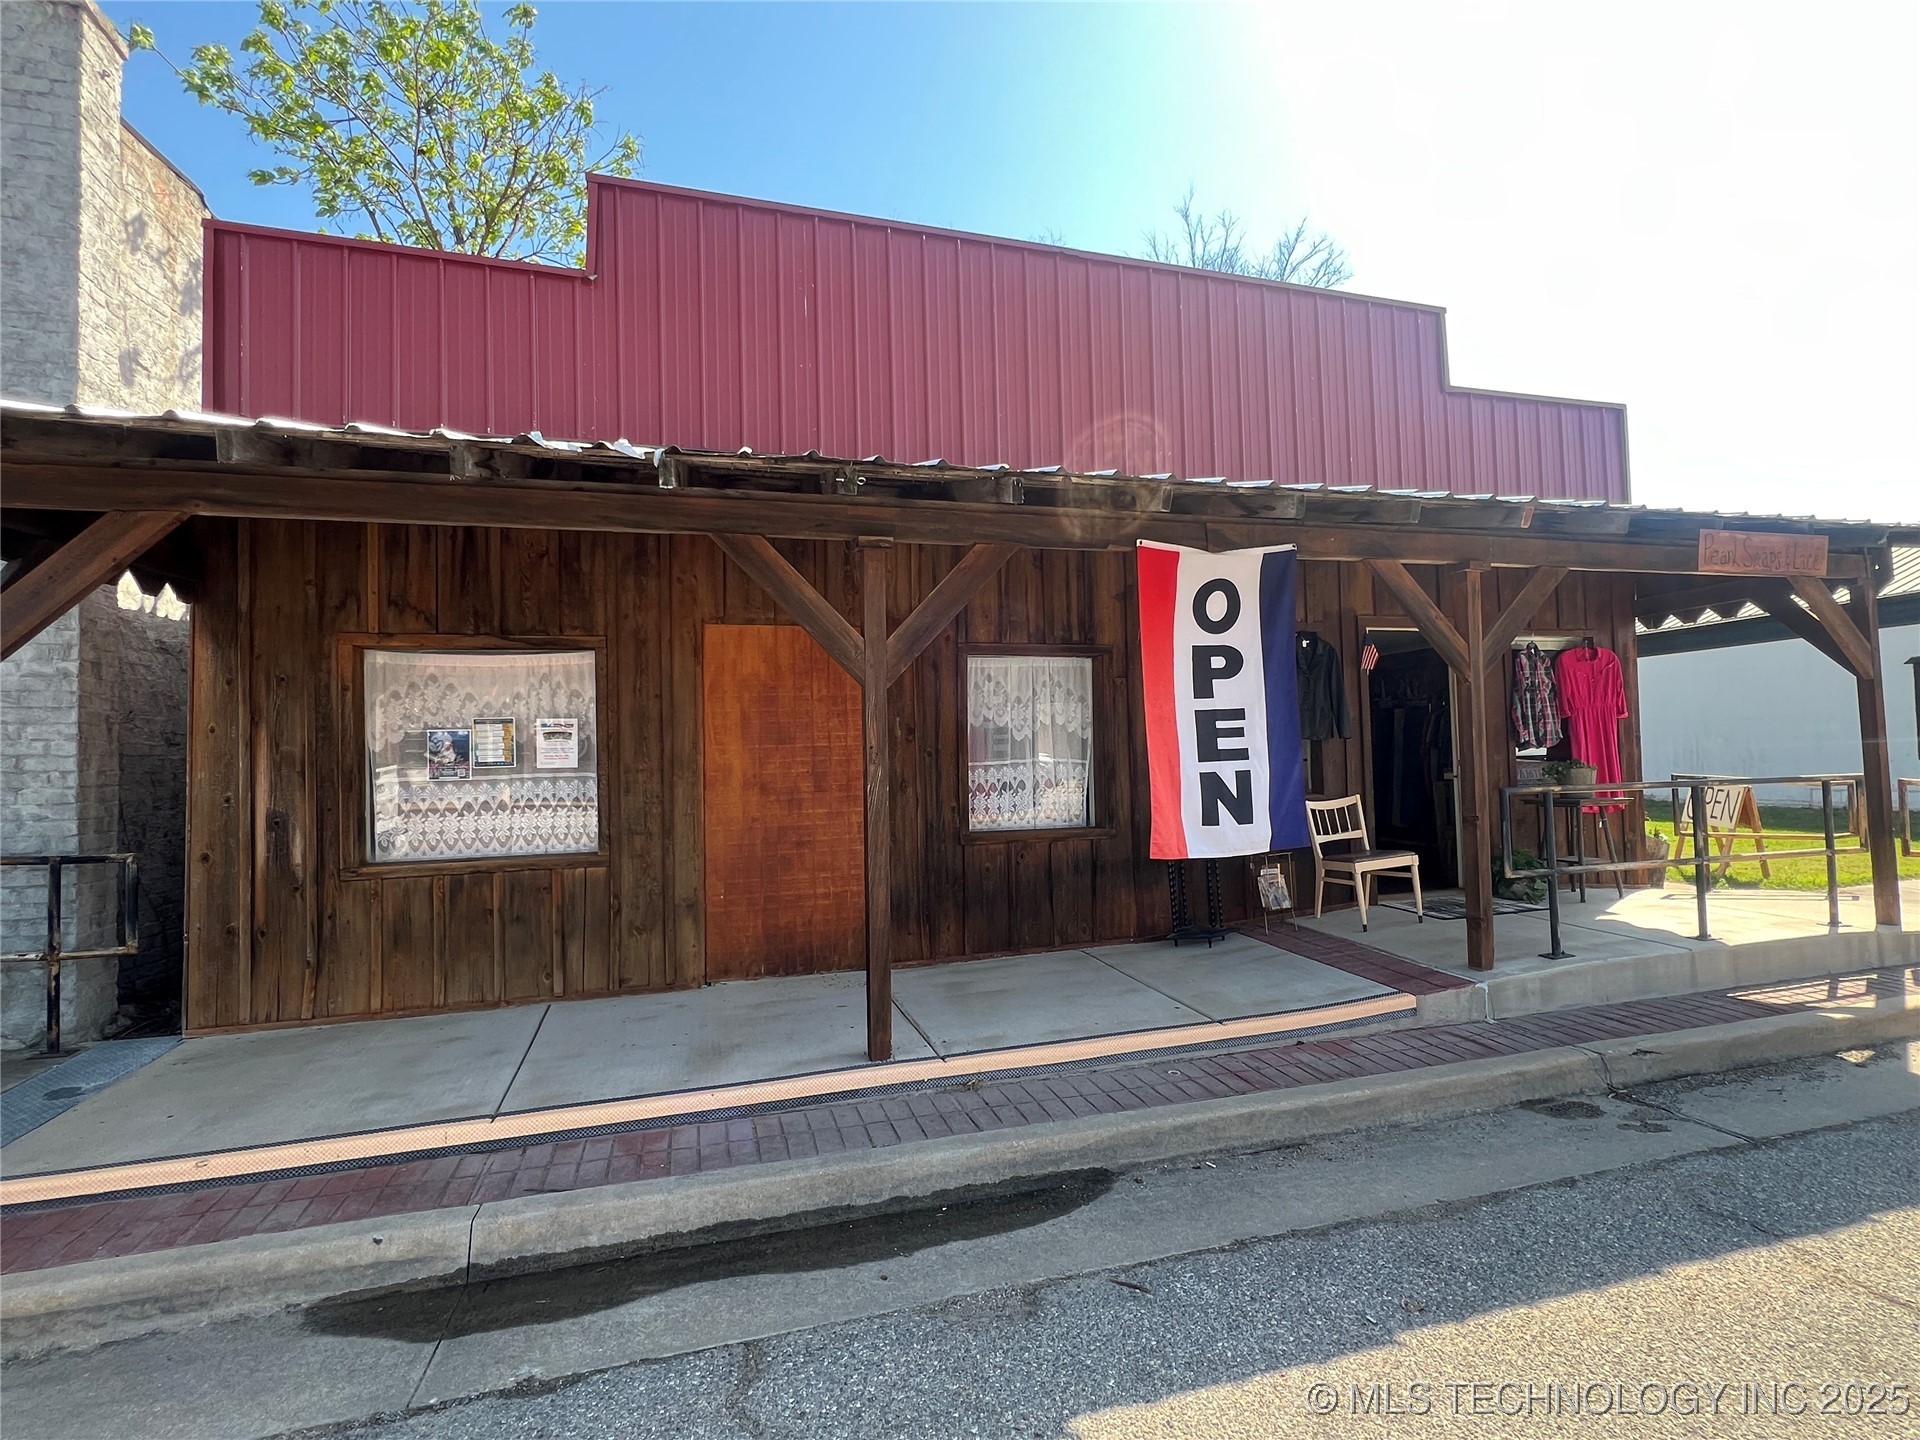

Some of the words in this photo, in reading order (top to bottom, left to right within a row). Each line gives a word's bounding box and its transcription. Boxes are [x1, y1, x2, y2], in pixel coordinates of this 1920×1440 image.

[1704, 533, 1740, 567] Pearl
[1793, 542, 1821, 571] Lace
[1192, 578, 1253, 826] OPEN
